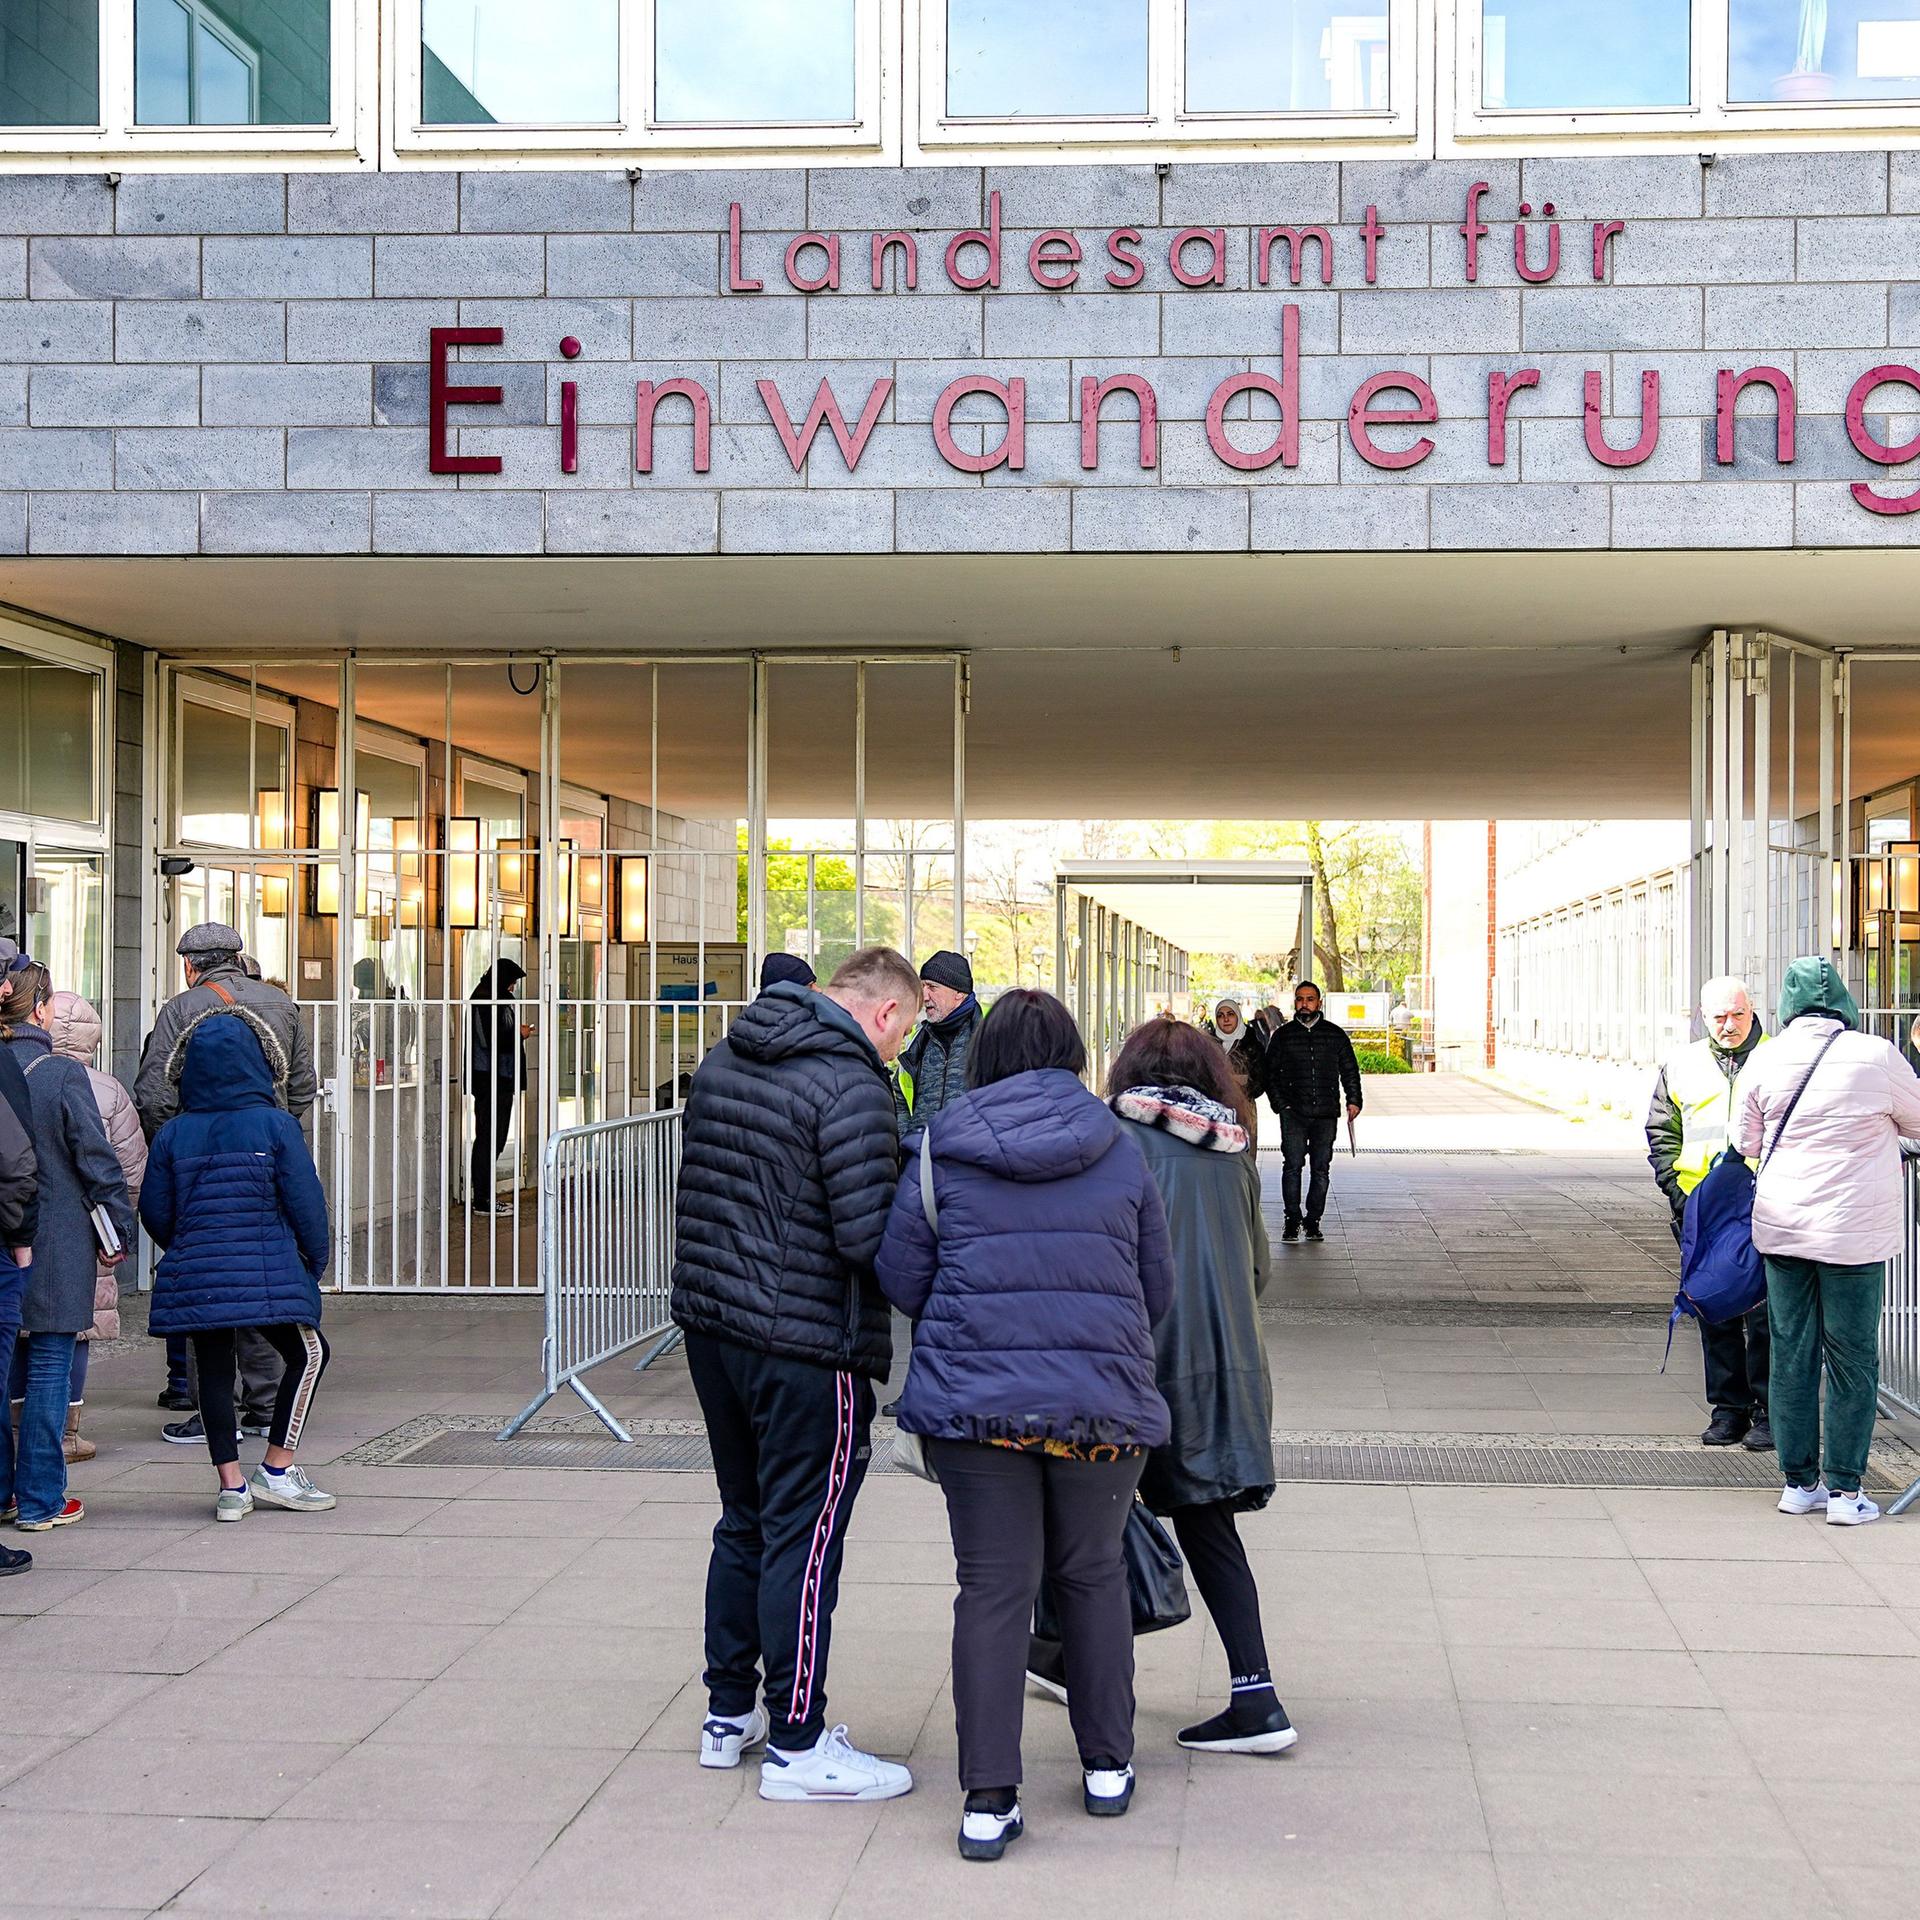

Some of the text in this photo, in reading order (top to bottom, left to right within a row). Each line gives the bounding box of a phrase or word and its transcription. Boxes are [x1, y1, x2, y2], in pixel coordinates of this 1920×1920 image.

[730, 181, 1625, 292] Landesamt für
[429, 304, 1920, 516] Einwanderung
[672, 955, 698, 965] Haus
